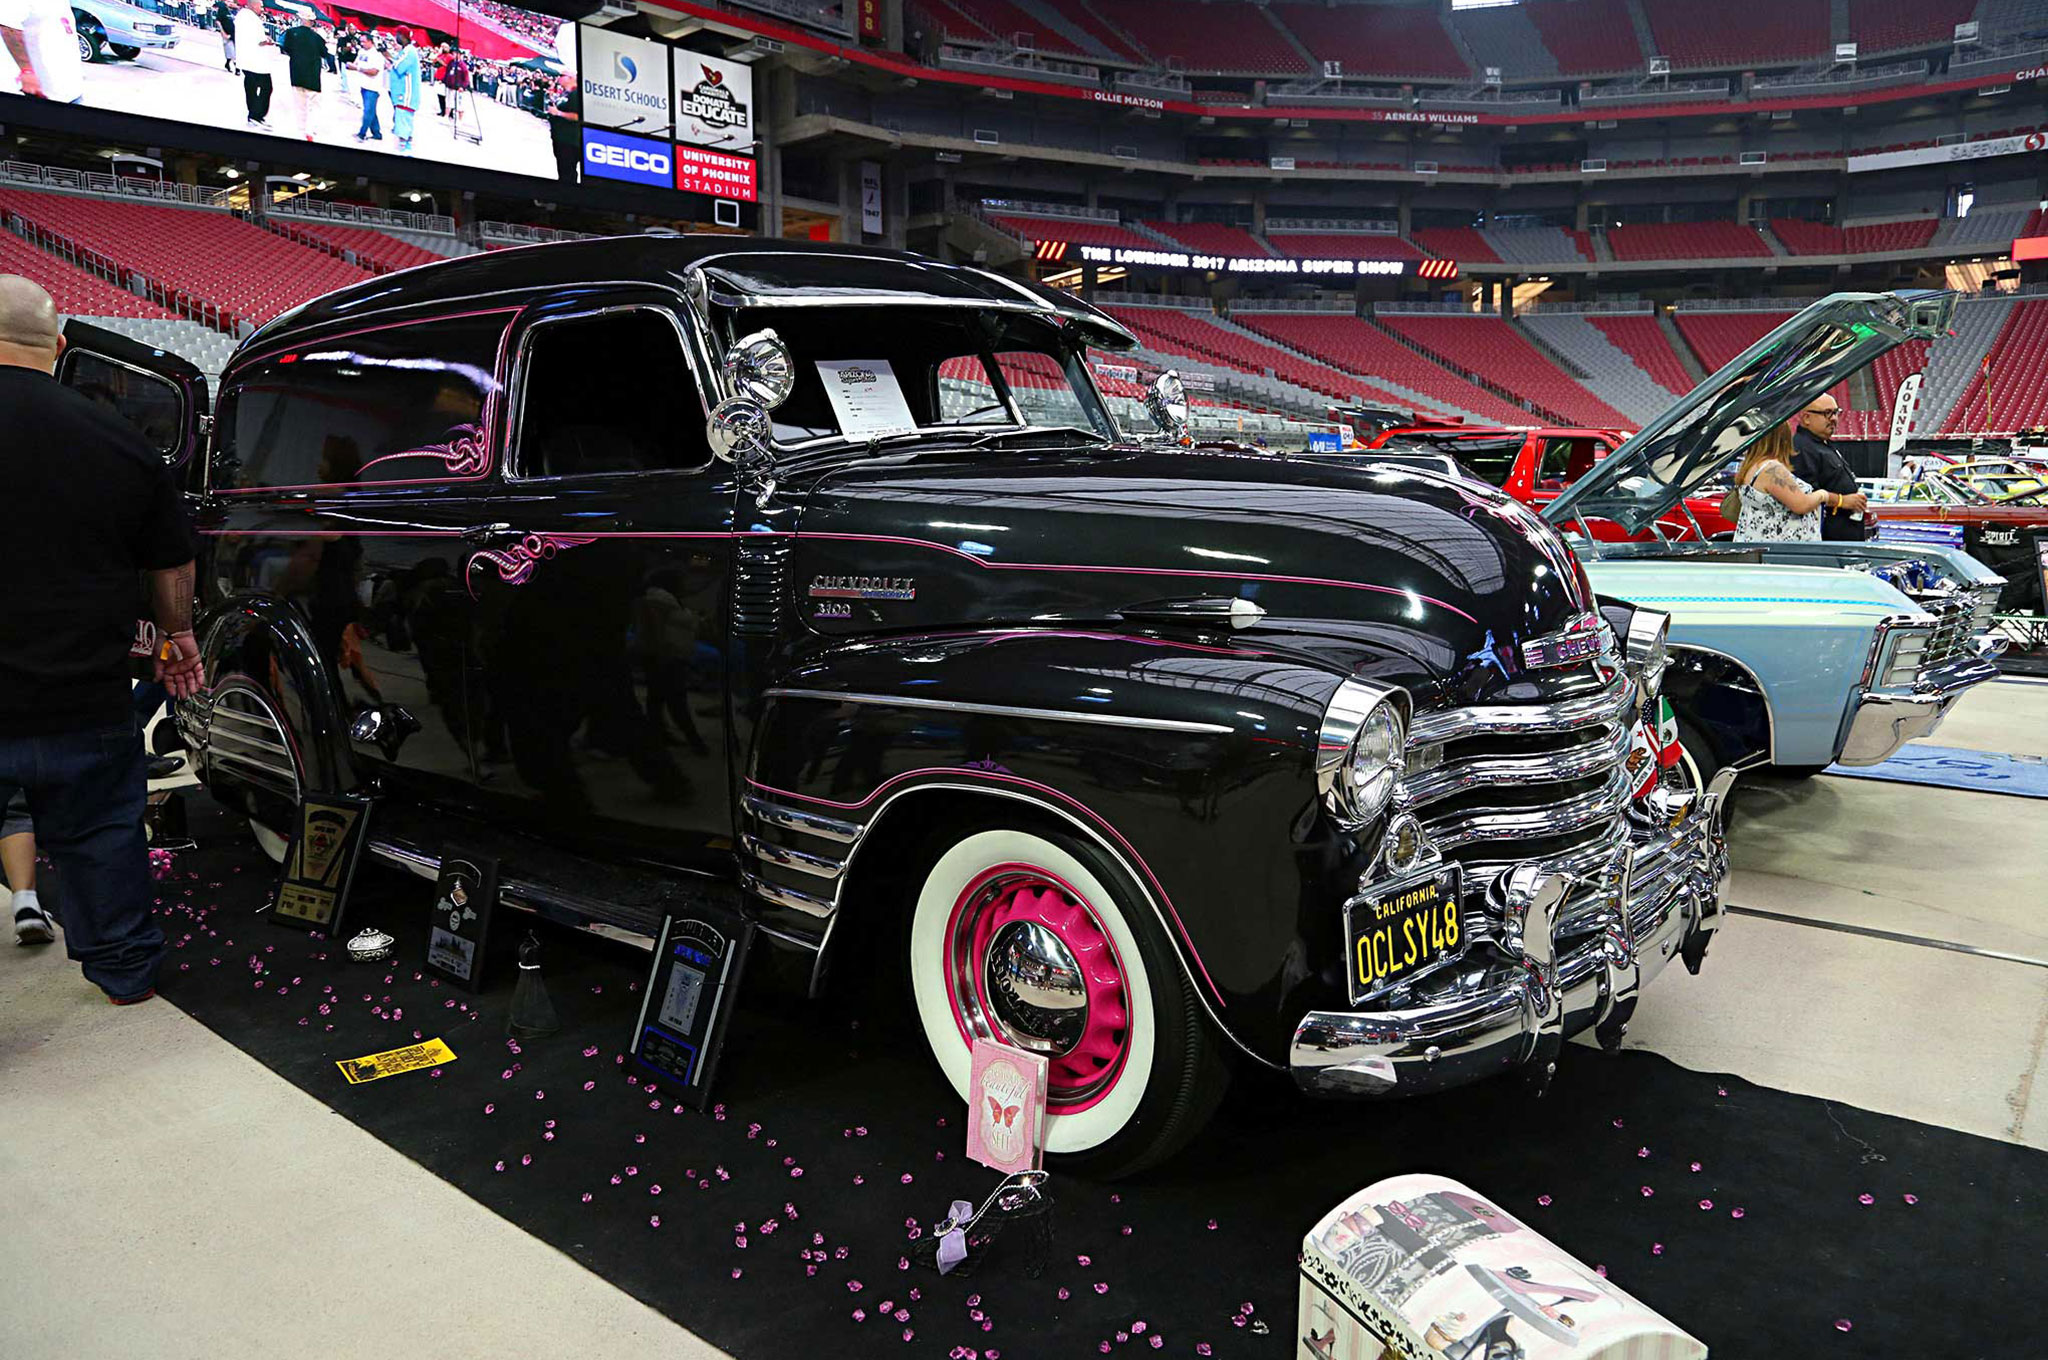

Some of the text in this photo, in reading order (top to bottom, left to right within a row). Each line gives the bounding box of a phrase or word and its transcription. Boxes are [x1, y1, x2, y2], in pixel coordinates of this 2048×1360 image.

[584, 79, 621, 100] DESERT
[624, 87, 667, 110] SCHOOLS
[693, 94, 731, 110] DONATE
[1094, 91, 1122, 104] OLLIE
[1124, 96, 1164, 109] MATSON
[683, 100, 746, 126] EDUCATE
[1384, 112, 1426, 122] AENEAS
[1428, 114, 1478, 123] WILLIAMS
[586, 142, 669, 174] GEICO
[1950, 138, 2023, 160] SAFEWAY
[683, 150, 750, 170] UNIVERSITY
[683, 164, 750, 184] OF PHOENIX
[684, 178, 750, 199] STADIUM
[1081, 246, 1404, 275] THE LOWRIDER 2017 ARIZONA SUPER SHOW
[1895, 381, 1913, 436] LOANS
[812, 575, 917, 591] CHEVROLET
[818, 603, 851, 615] 3100
[1376, 885, 1436, 920] CALIFORNIA
[1357, 901, 1459, 985] OCLSY48
